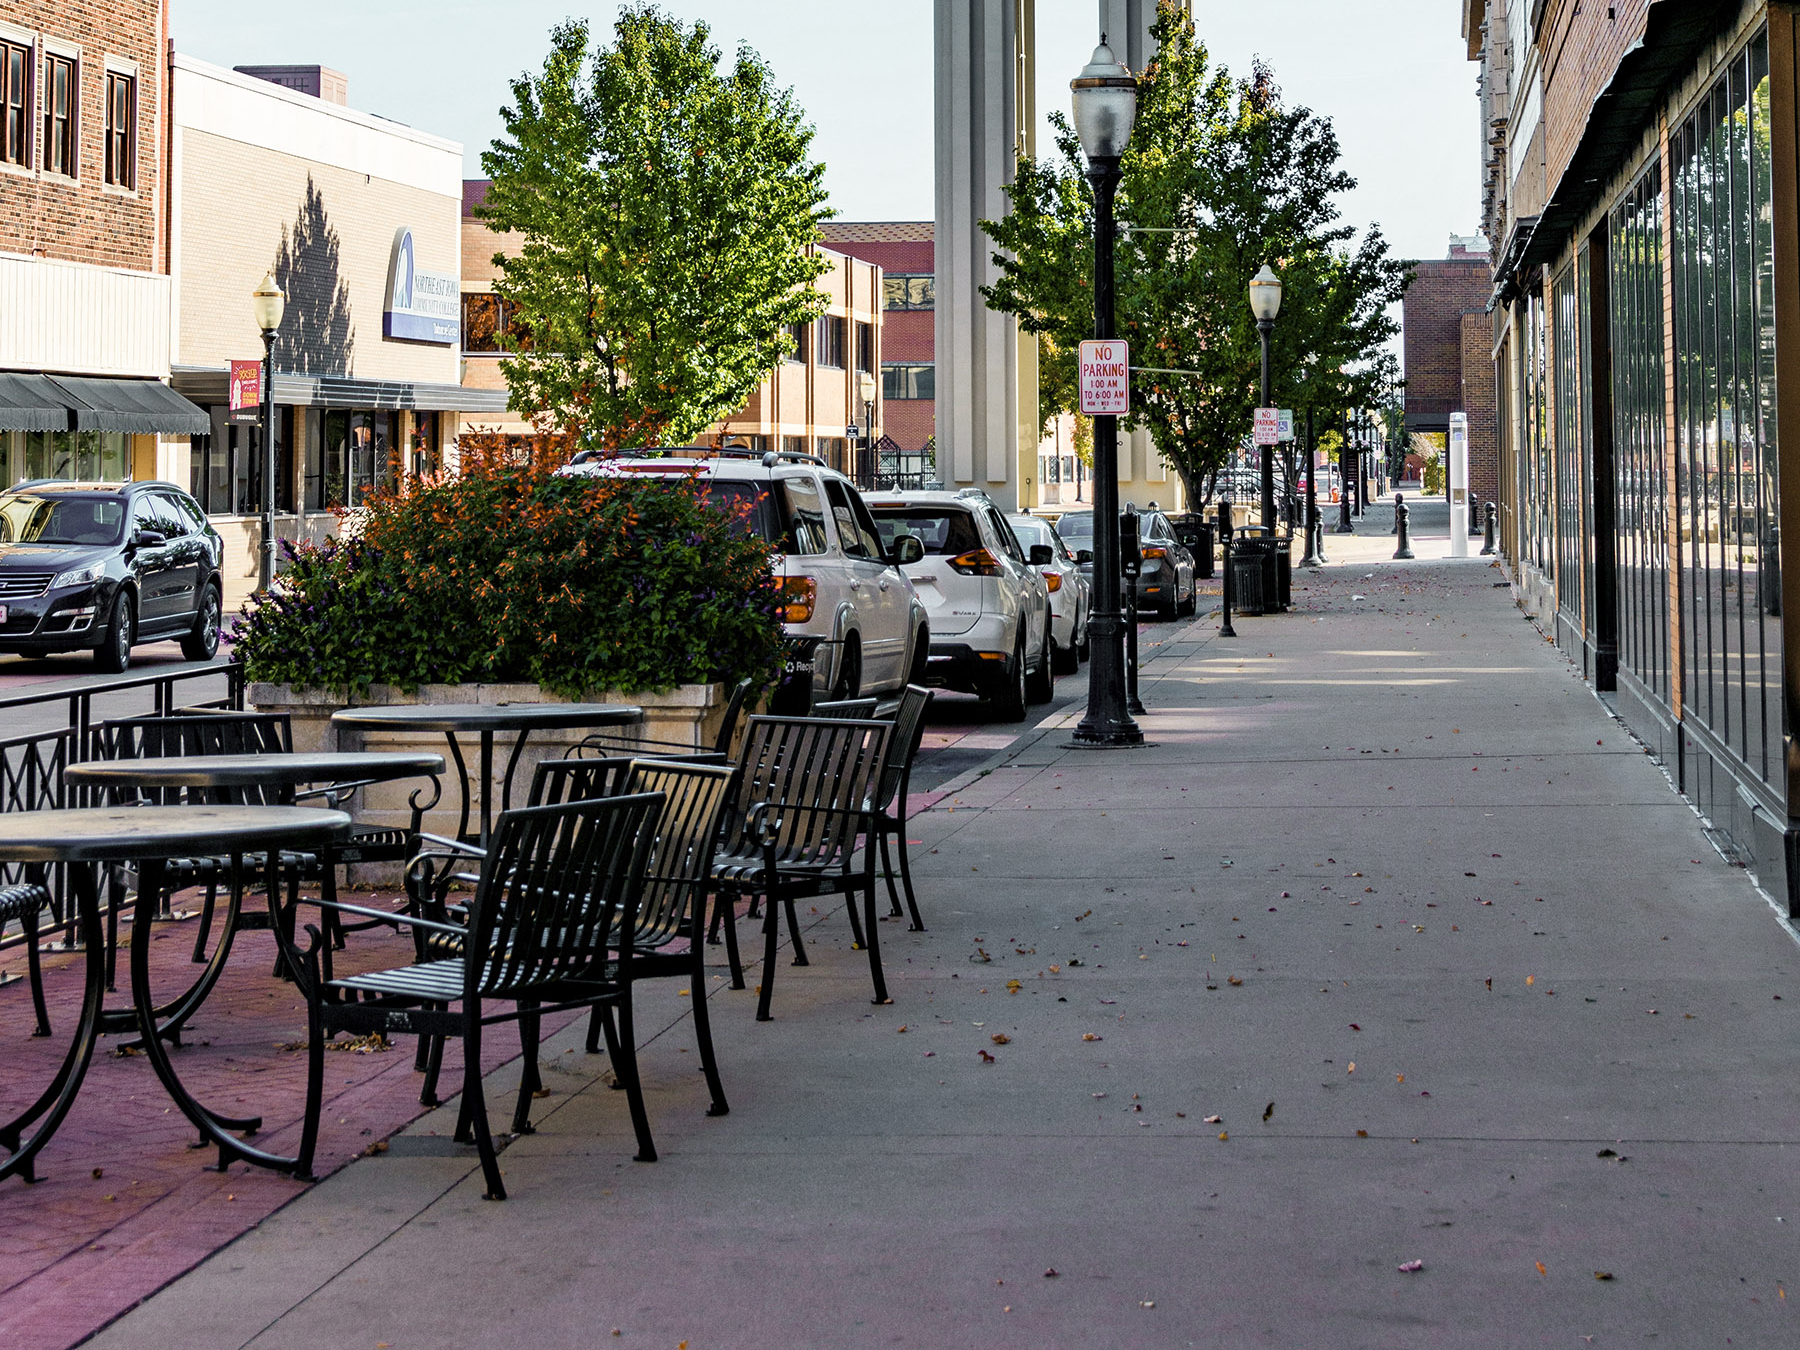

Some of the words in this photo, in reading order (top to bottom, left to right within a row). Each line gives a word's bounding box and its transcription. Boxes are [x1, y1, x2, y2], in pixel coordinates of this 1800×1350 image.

[1095, 347, 1112, 361] NO
[1083, 363, 1124, 377] PARKING
[1091, 379, 1105, 388] 1:00
[1107, 379, 1118, 388] AM
[1084, 391, 1093, 399] TO
[1095, 391, 1111, 399] 6:00
[1114, 391, 1124, 399] AM
[1262, 411, 1271, 419] NO
